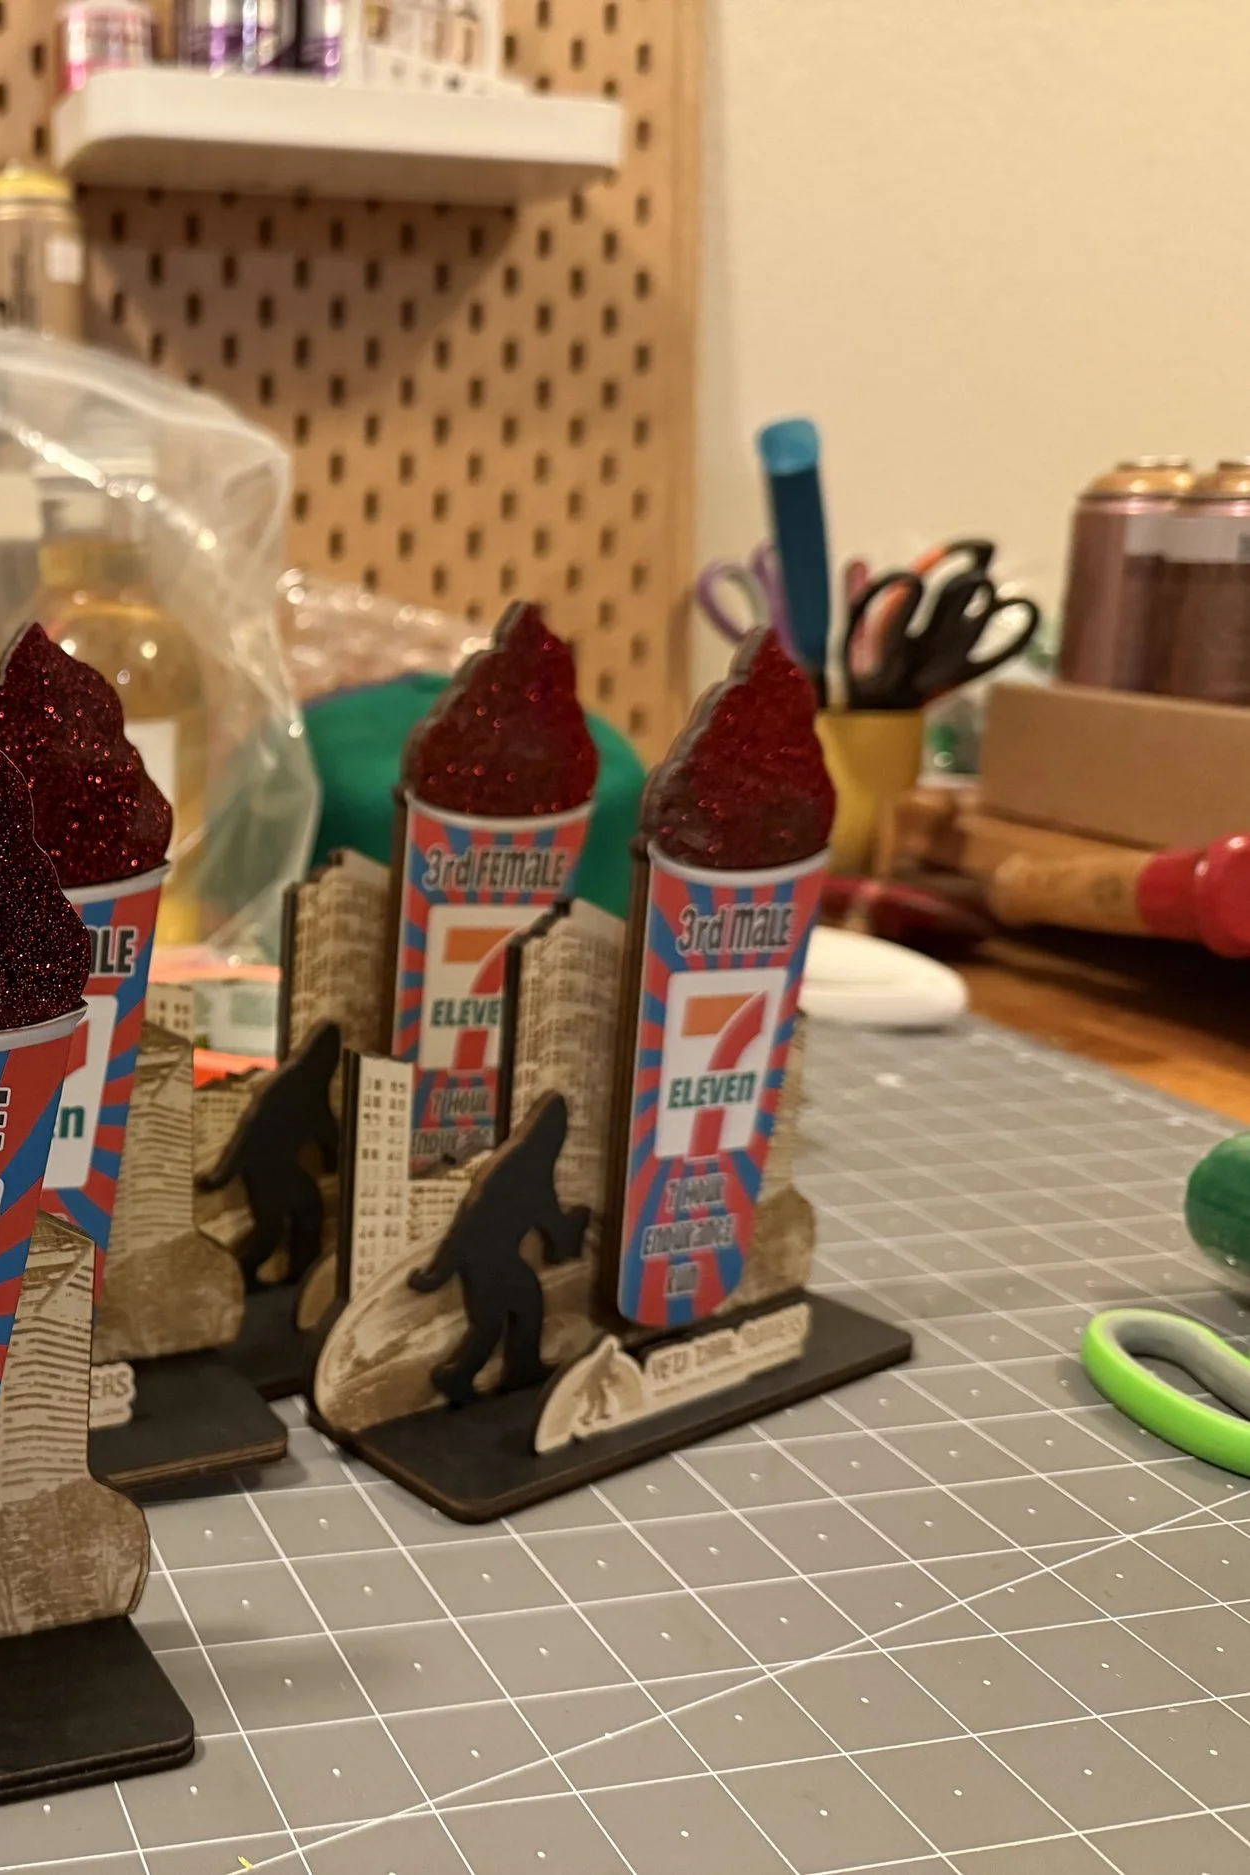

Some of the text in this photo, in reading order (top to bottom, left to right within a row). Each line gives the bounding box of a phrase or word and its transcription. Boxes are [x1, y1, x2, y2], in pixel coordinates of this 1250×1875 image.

[422, 842, 474, 891] 3rd
[676, 902, 726, 956] 3rd
[430, 998, 500, 1028] ELEVE
